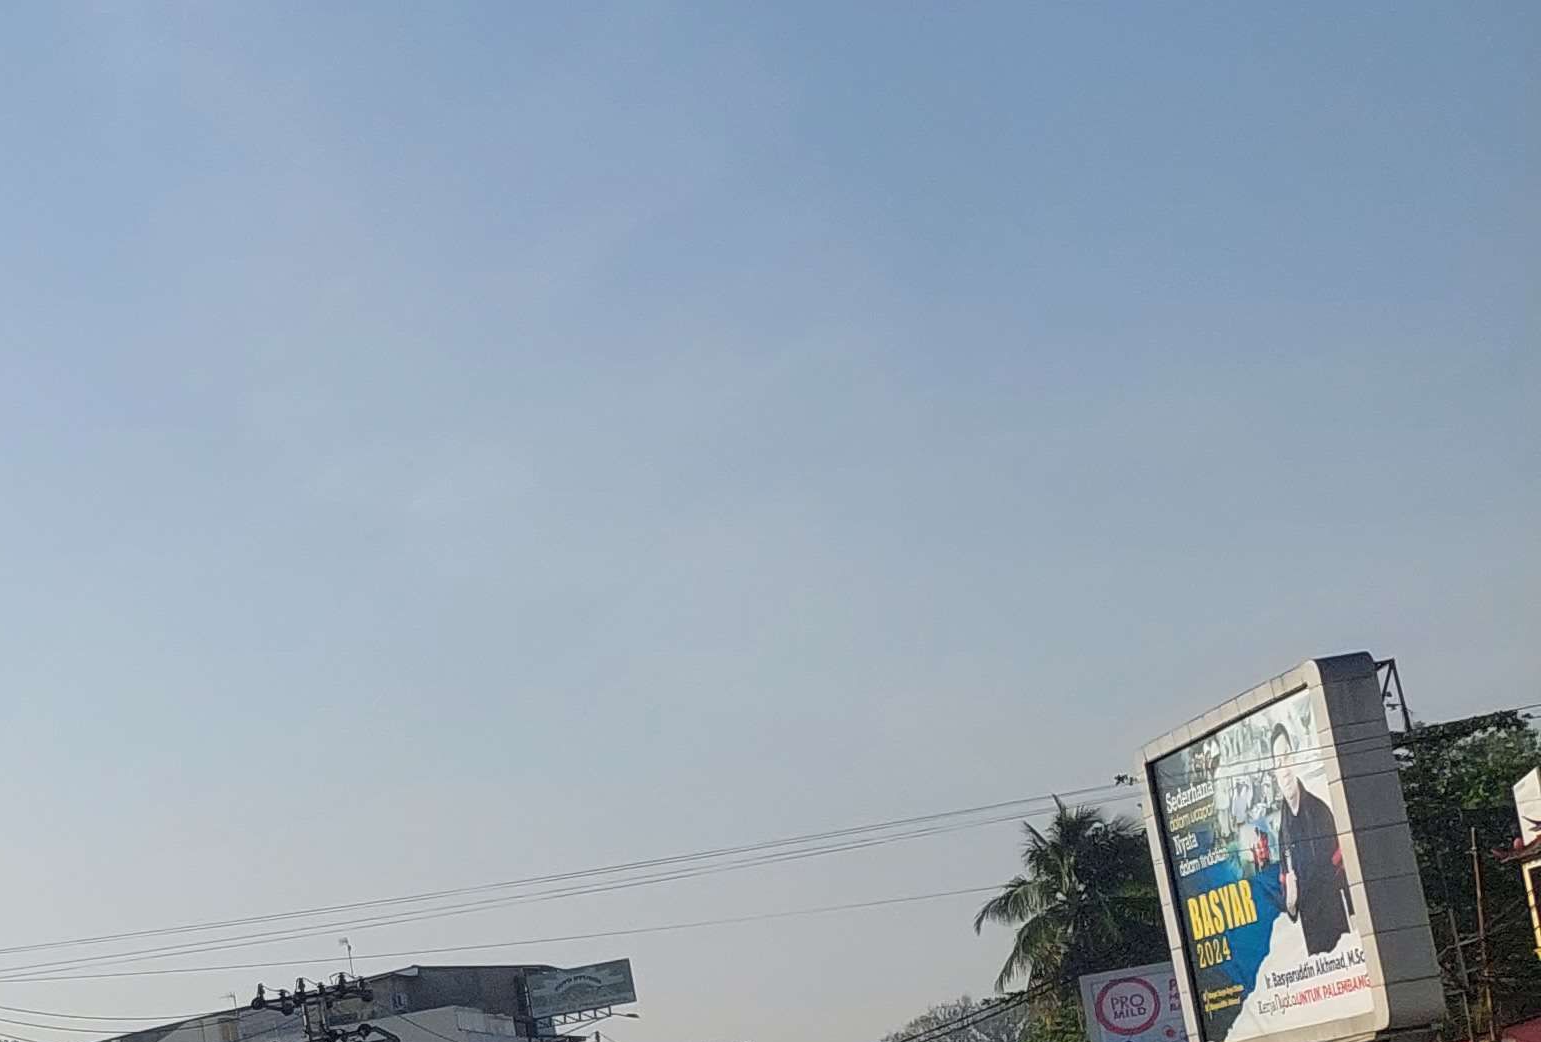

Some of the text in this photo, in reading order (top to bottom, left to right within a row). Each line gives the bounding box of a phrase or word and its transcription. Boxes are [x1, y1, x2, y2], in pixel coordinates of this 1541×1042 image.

[1165, 781, 1215, 814] Sederhana
[1173, 832, 1199, 858] Nyata
[1187, 879, 1258, 941] BASYAR
[1197, 936, 1231, 969] 2024
[1111, 994, 1144, 1010] PRO
[1296, 989, 1321, 1008] UNTUK
[1322, 974, 1371, 1000] PALEMBANG
[1114, 1007, 1146, 1019] MILD
